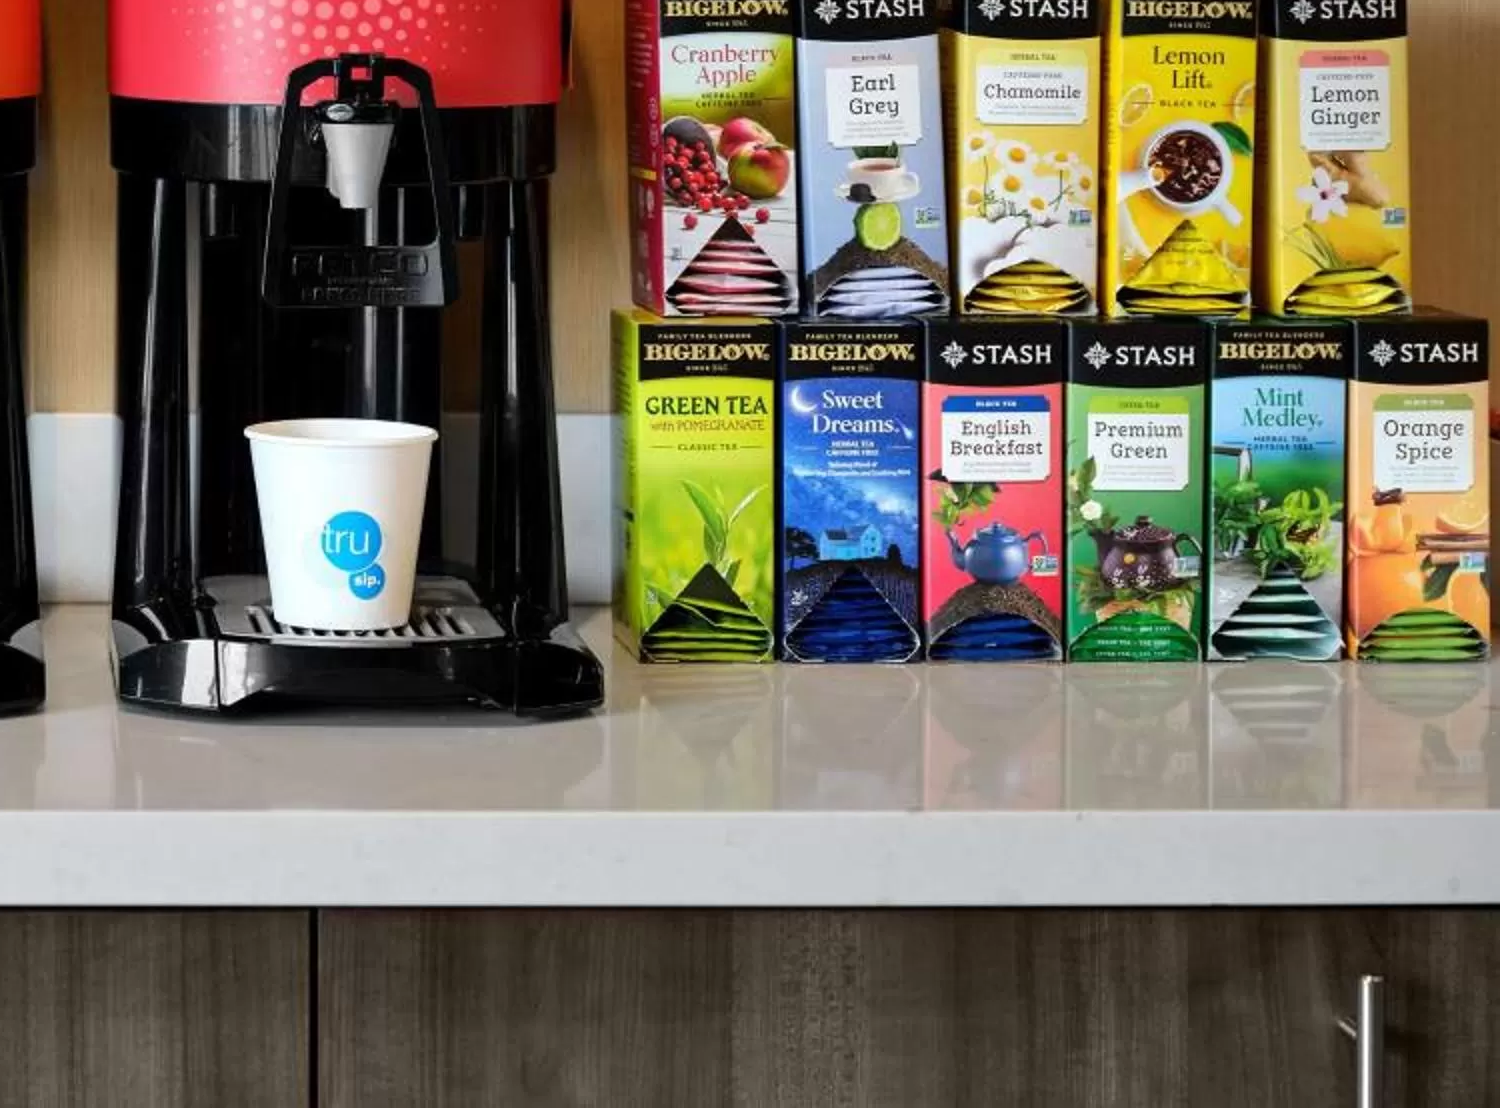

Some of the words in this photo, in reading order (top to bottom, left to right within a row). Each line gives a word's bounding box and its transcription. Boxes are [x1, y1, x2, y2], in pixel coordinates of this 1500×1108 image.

[1320, 0, 1396, 19] STASH
[671, 43, 778, 67] Cranberry
[1153, 46, 1225, 65] Lemon
[695, 64, 757, 89] Apple
[851, 73, 896, 93] Earl
[983, 83, 1082, 99] Chamomile
[1311, 86, 1380, 103] Lemon
[849, 98, 899, 118] Grey
[1311, 107, 1381, 129] Ginger
[972, 344, 1052, 365] STASH
[1115, 345, 1195, 366] STASH
[1400, 343, 1479, 363] STASH
[645, 396, 719, 415] GREEN
[726, 396, 768, 415] TEA
[822, 390, 884, 409] Sweet
[1255, 388, 1303, 407] Mint
[651, 420, 674, 432] with
[676, 419, 765, 431] POMEGRANATE
[961, 420, 1032, 438] English
[1094, 421, 1183, 438] Premium
[1383, 419, 1465, 441] Orange
[950, 440, 1043, 456] Breakfast
[1110, 443, 1168, 459] Green
[1396, 442, 1453, 464] Spice
[322, 524, 369, 555] tru
